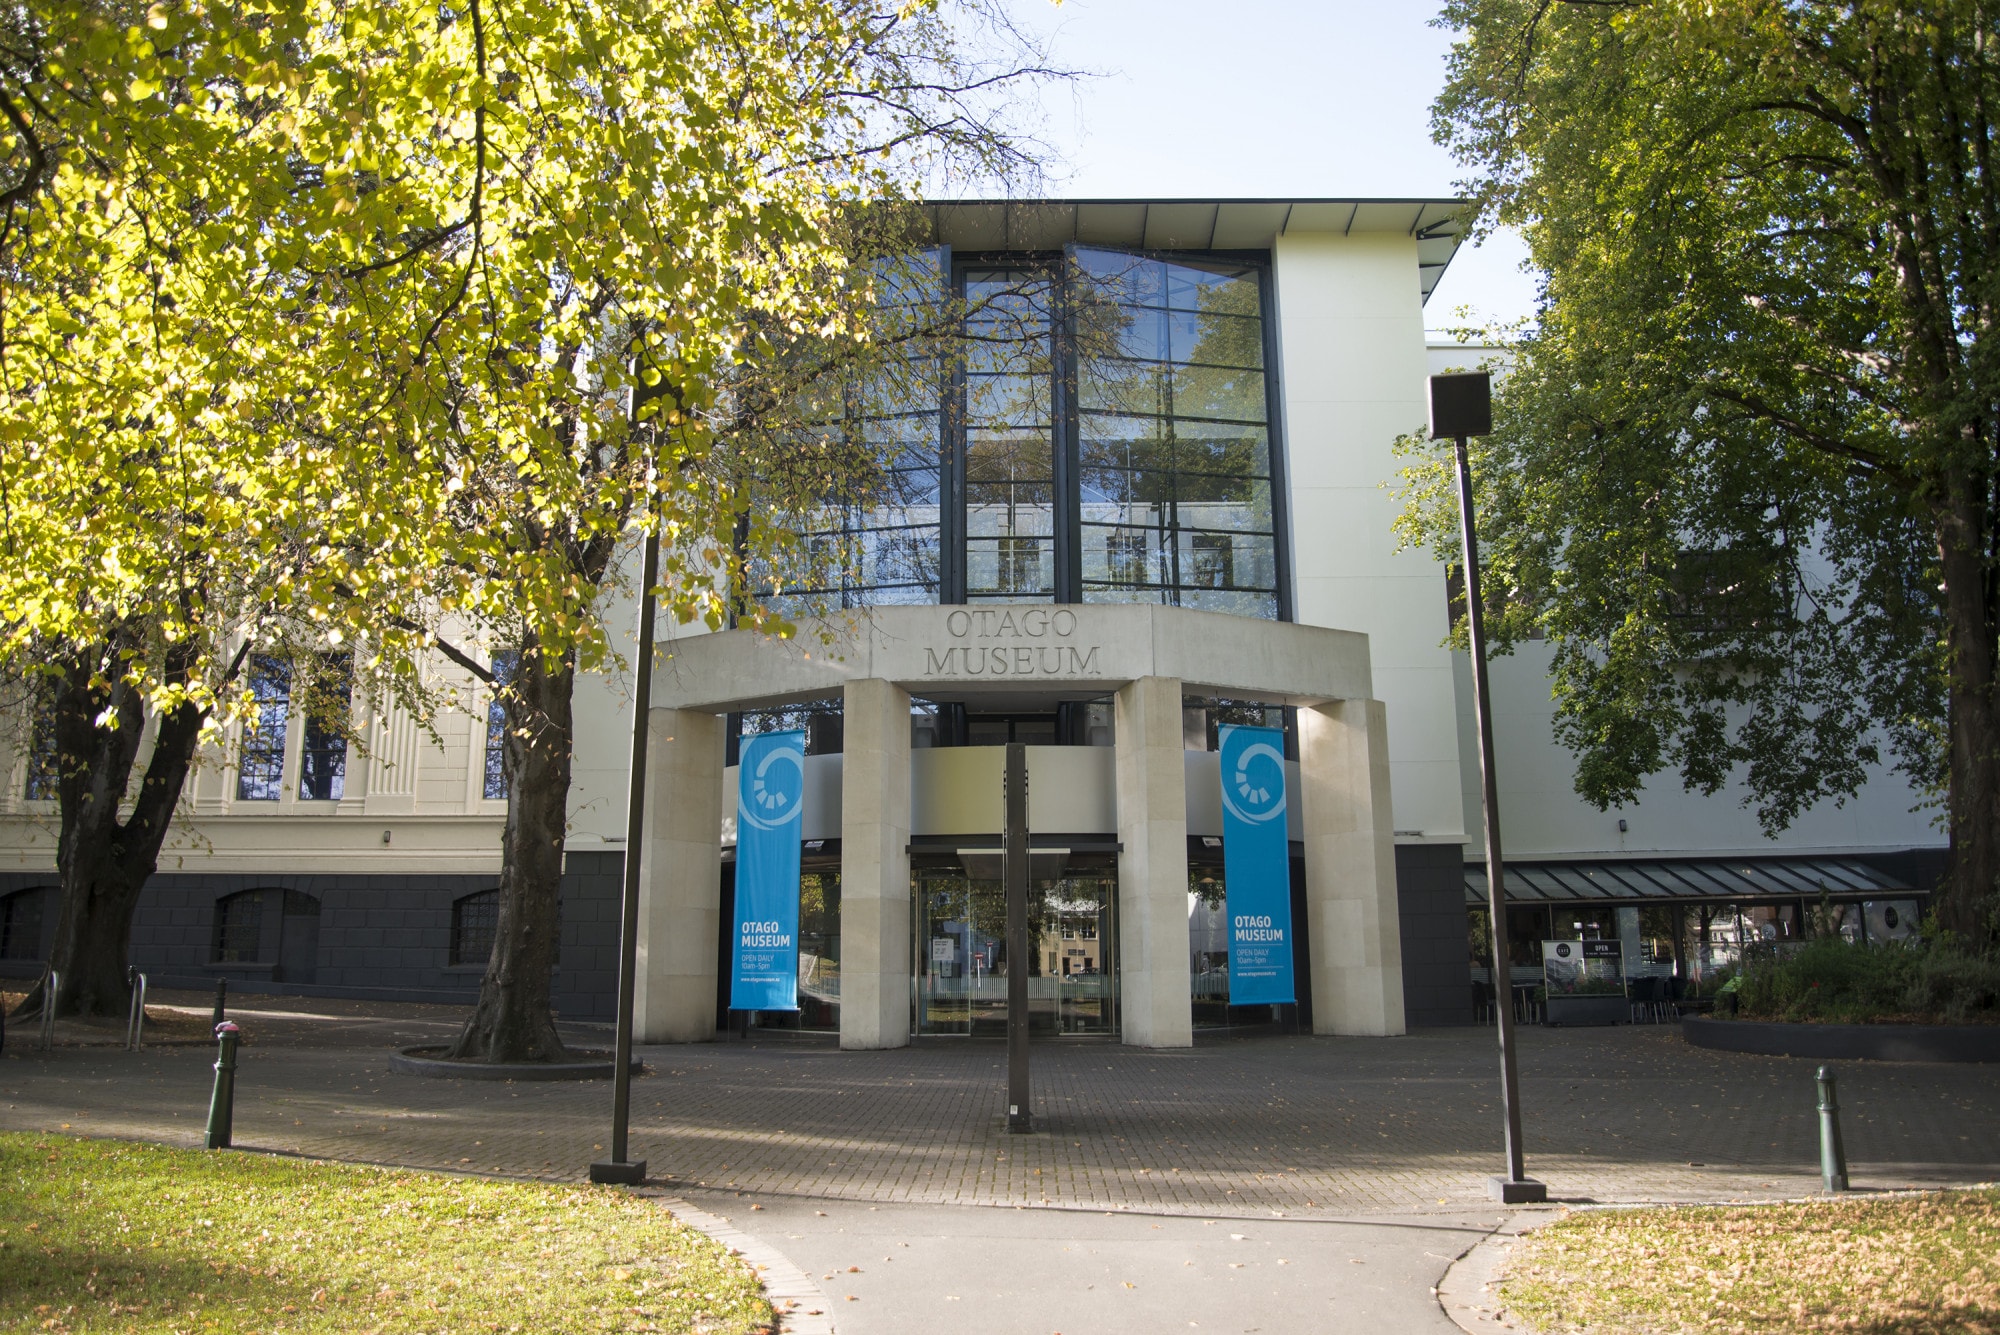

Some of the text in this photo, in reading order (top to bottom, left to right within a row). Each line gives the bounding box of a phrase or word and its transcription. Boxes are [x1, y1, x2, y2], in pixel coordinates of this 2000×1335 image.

[946, 609, 1077, 638] OTAGO
[923, 646, 1101, 675] MUSEUM
[741, 921, 779, 934] OTAGO
[1234, 915, 1271, 928] OTAGO
[741, 934, 790, 947] MUSEUM
[1235, 928, 1283, 941] MUSEUM
[1236, 948, 1269, 956] OPEN DAILY
[1595, 944, 1609, 952] OPEN
[741, 954, 774, 962] OPEN DAILY
